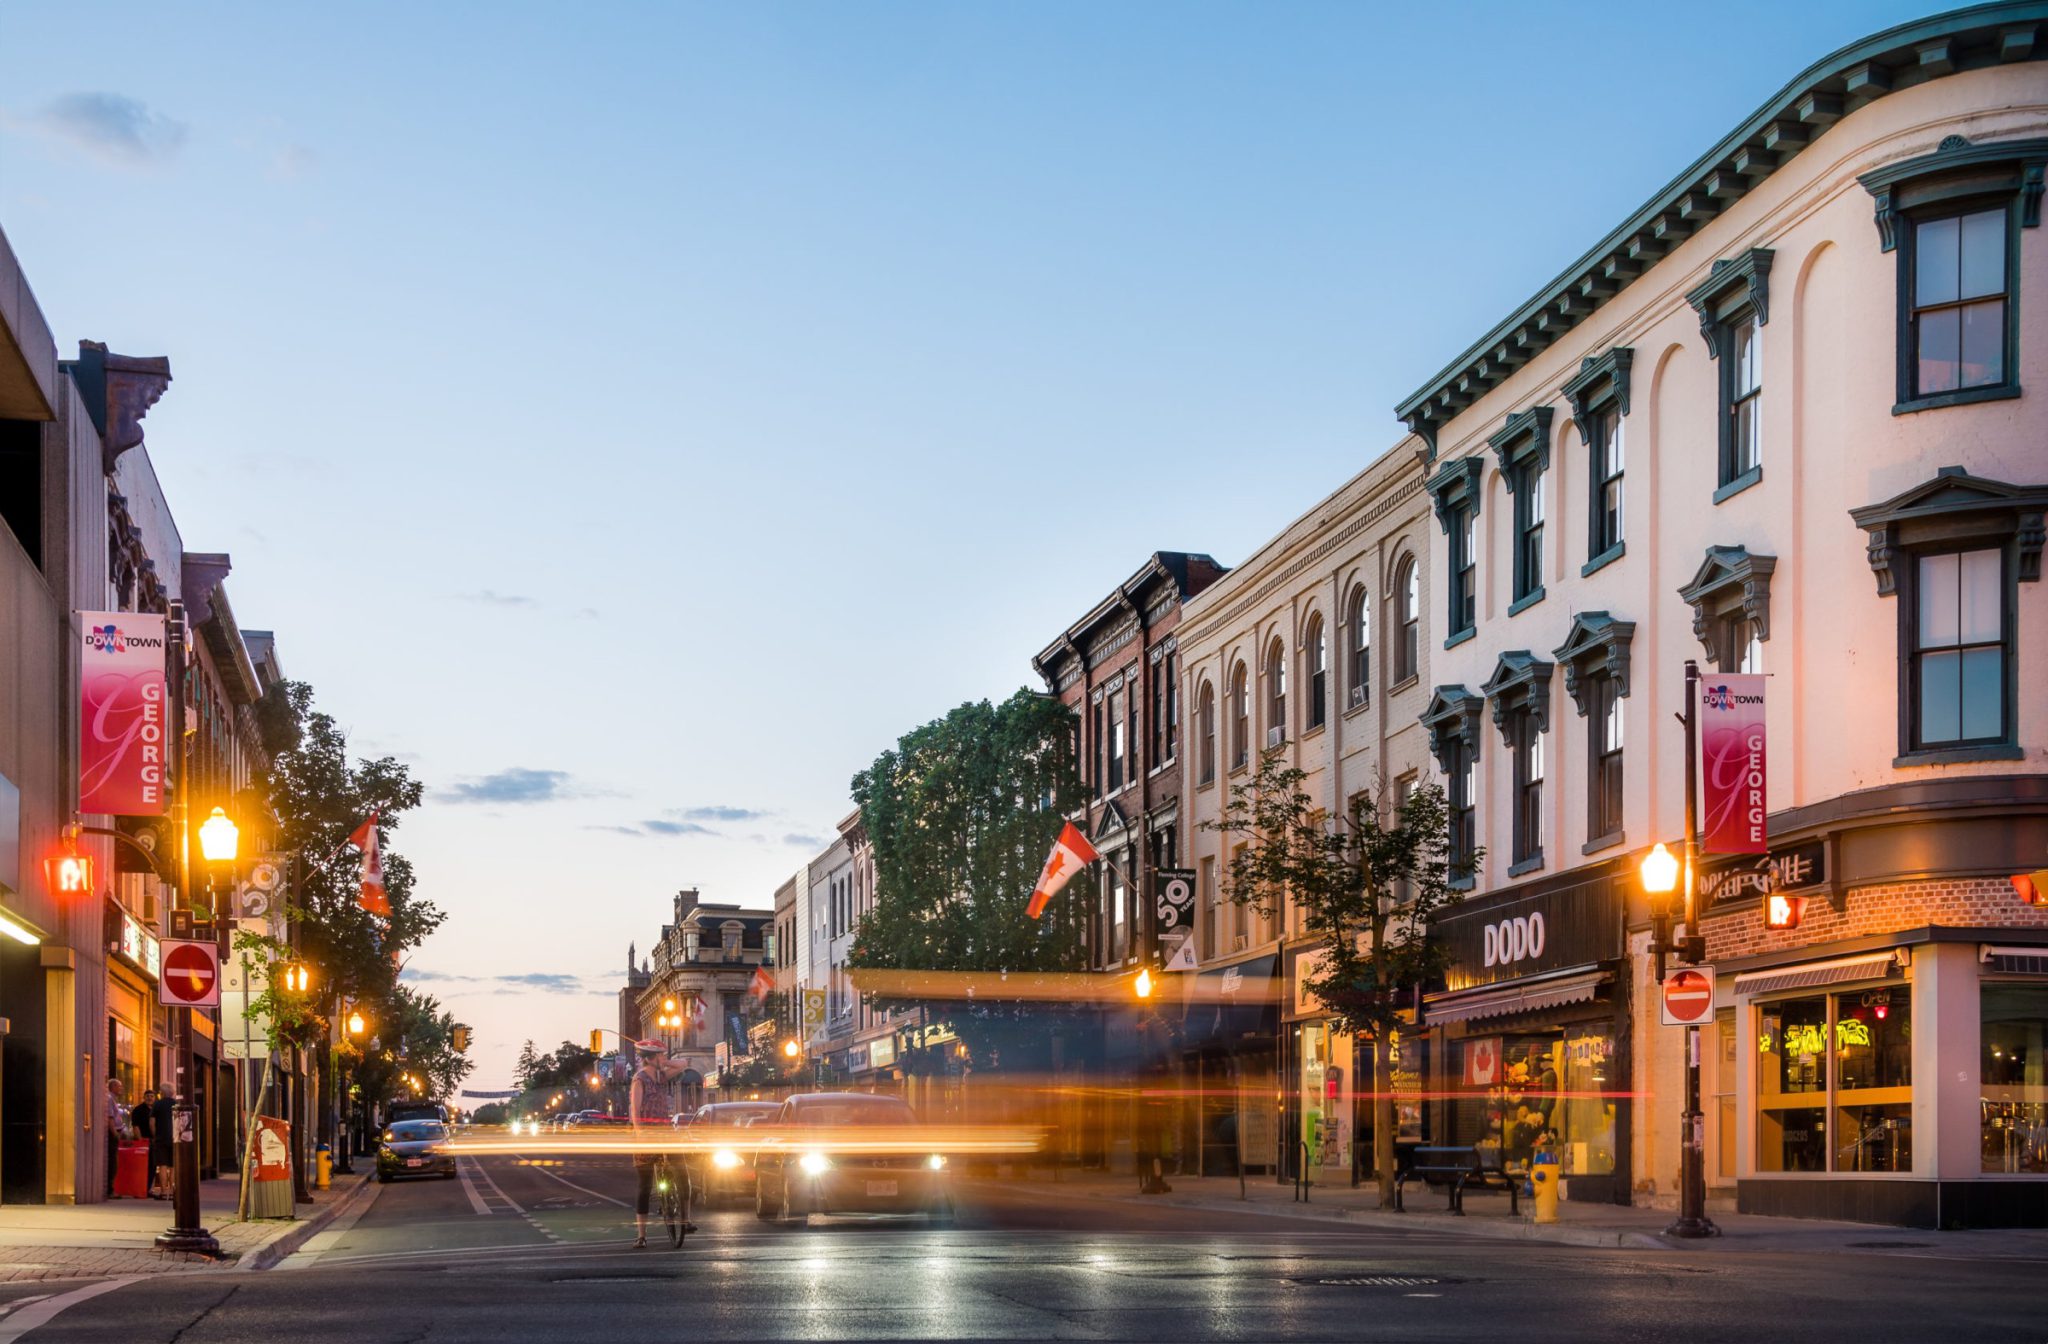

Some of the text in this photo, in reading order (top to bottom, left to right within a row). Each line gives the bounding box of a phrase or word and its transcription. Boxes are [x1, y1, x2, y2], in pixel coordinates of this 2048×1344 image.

[85, 634, 162, 648] DOWNTOWN
[1703, 695, 1764, 705] DOWNTOWN
[140, 683, 160, 804] GEORGE
[1747, 735, 1763, 843] GEORGE
[1157, 879, 1190, 928] 50
[1484, 911, 1545, 968] DODO
